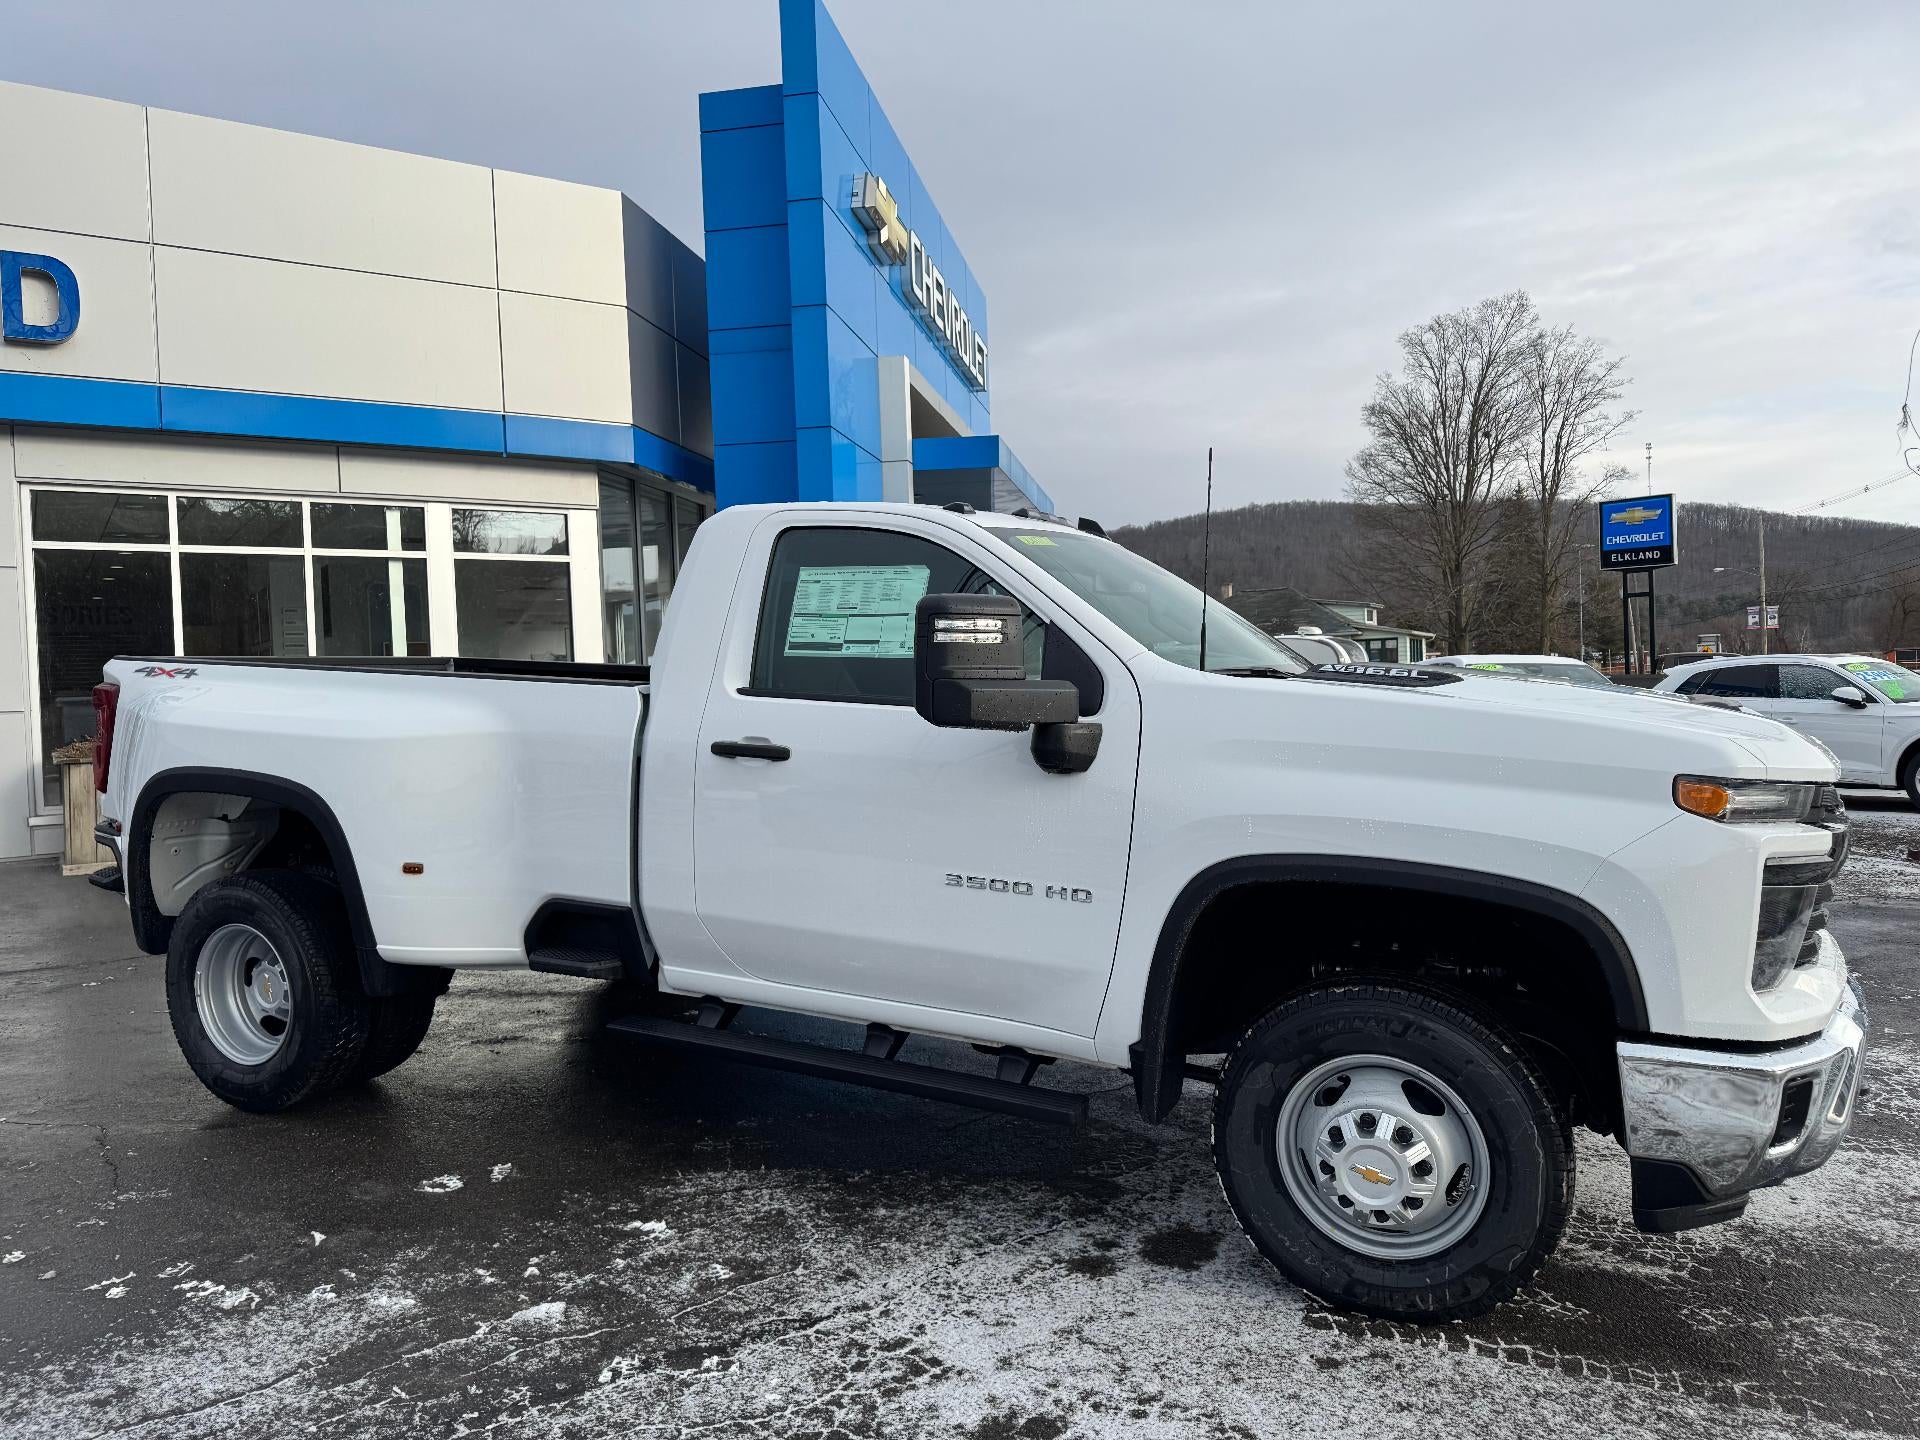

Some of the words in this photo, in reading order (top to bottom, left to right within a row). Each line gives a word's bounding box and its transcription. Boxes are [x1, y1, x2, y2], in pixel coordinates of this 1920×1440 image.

[0, 250, 80, 344] D
[907, 229, 988, 392] CHEVROLET
[1606, 532, 1665, 545] CHEVROLET
[1611, 550, 1661, 562] ELKLAND
[1365, 666, 1429, 679] 6.6L
[944, 872, 1034, 896] 3500
[1045, 884, 1093, 904] HD
